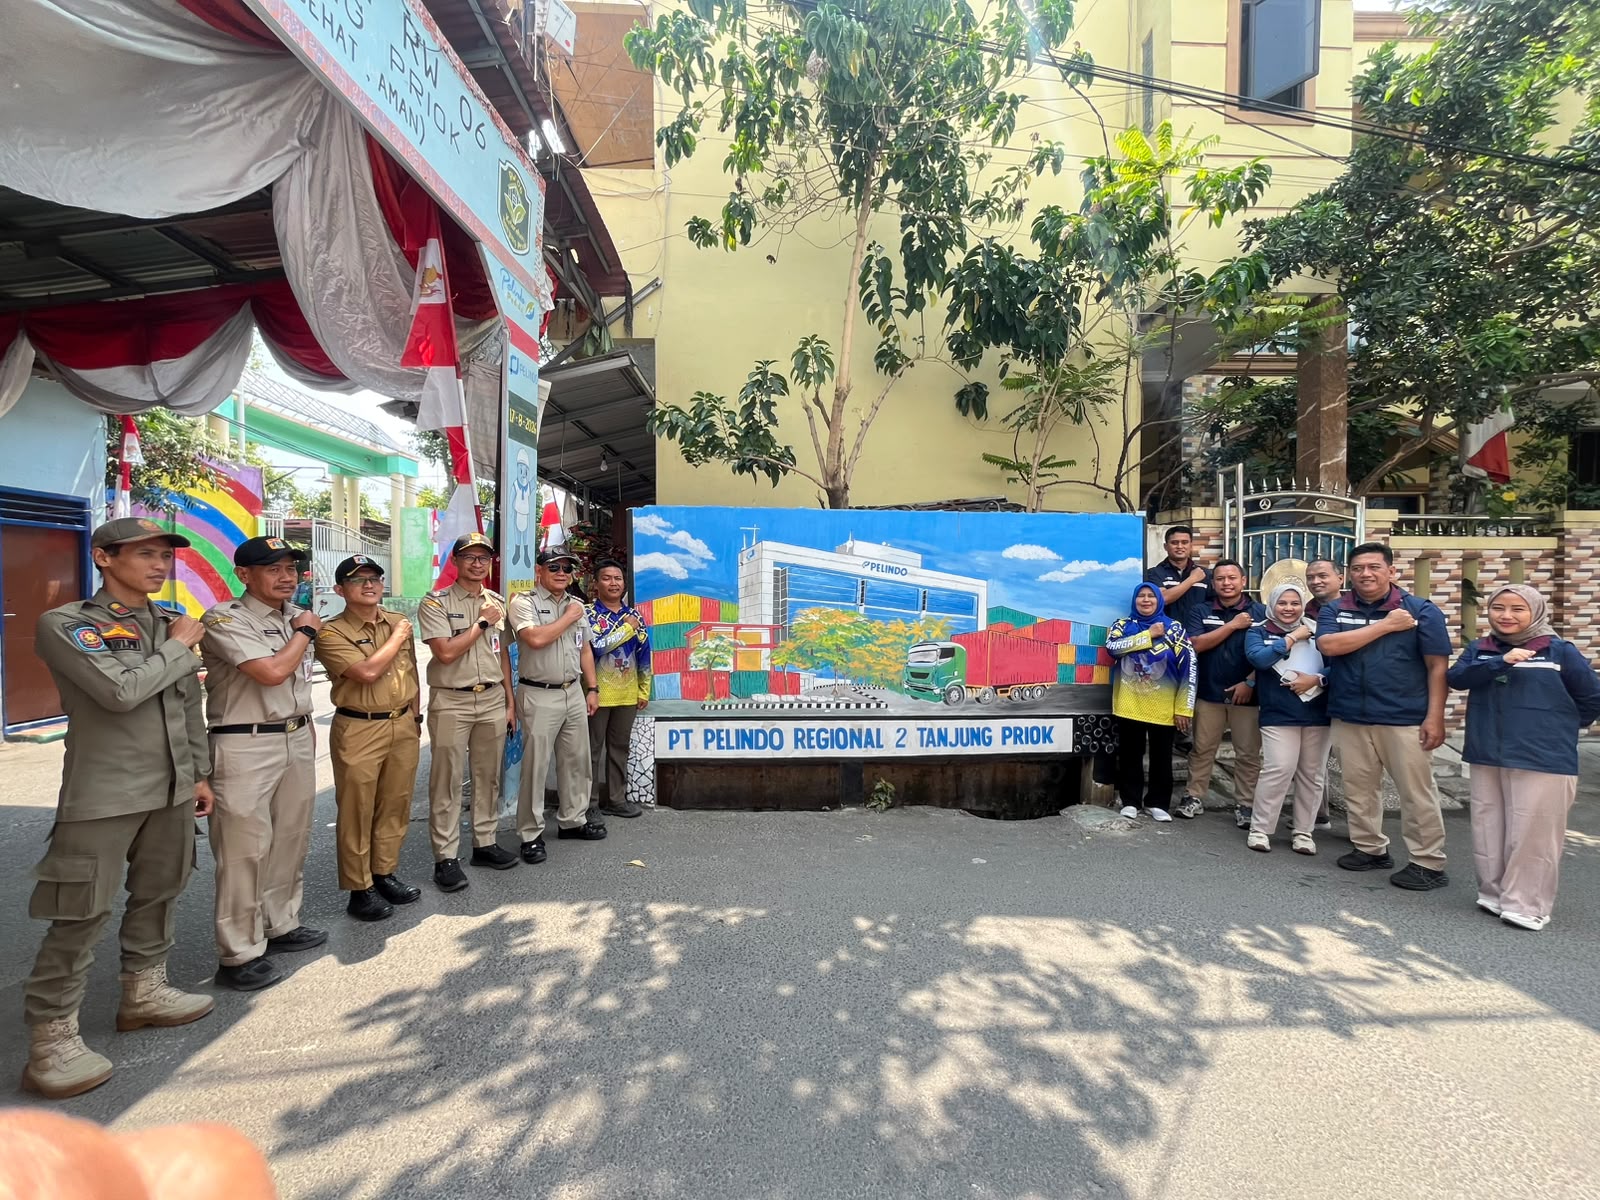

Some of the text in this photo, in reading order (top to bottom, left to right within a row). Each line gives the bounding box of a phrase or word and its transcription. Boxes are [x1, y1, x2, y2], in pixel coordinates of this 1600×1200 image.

[301, 0, 358, 63] EHAT
[389, 43, 460, 155] PRIOK
[403, 12, 486, 150] RW 06
[870, 562, 908, 576] PELINDO
[668, 725, 1055, 751] PT PELINDO REGIONAL 2 TANJUNG PRIOK
